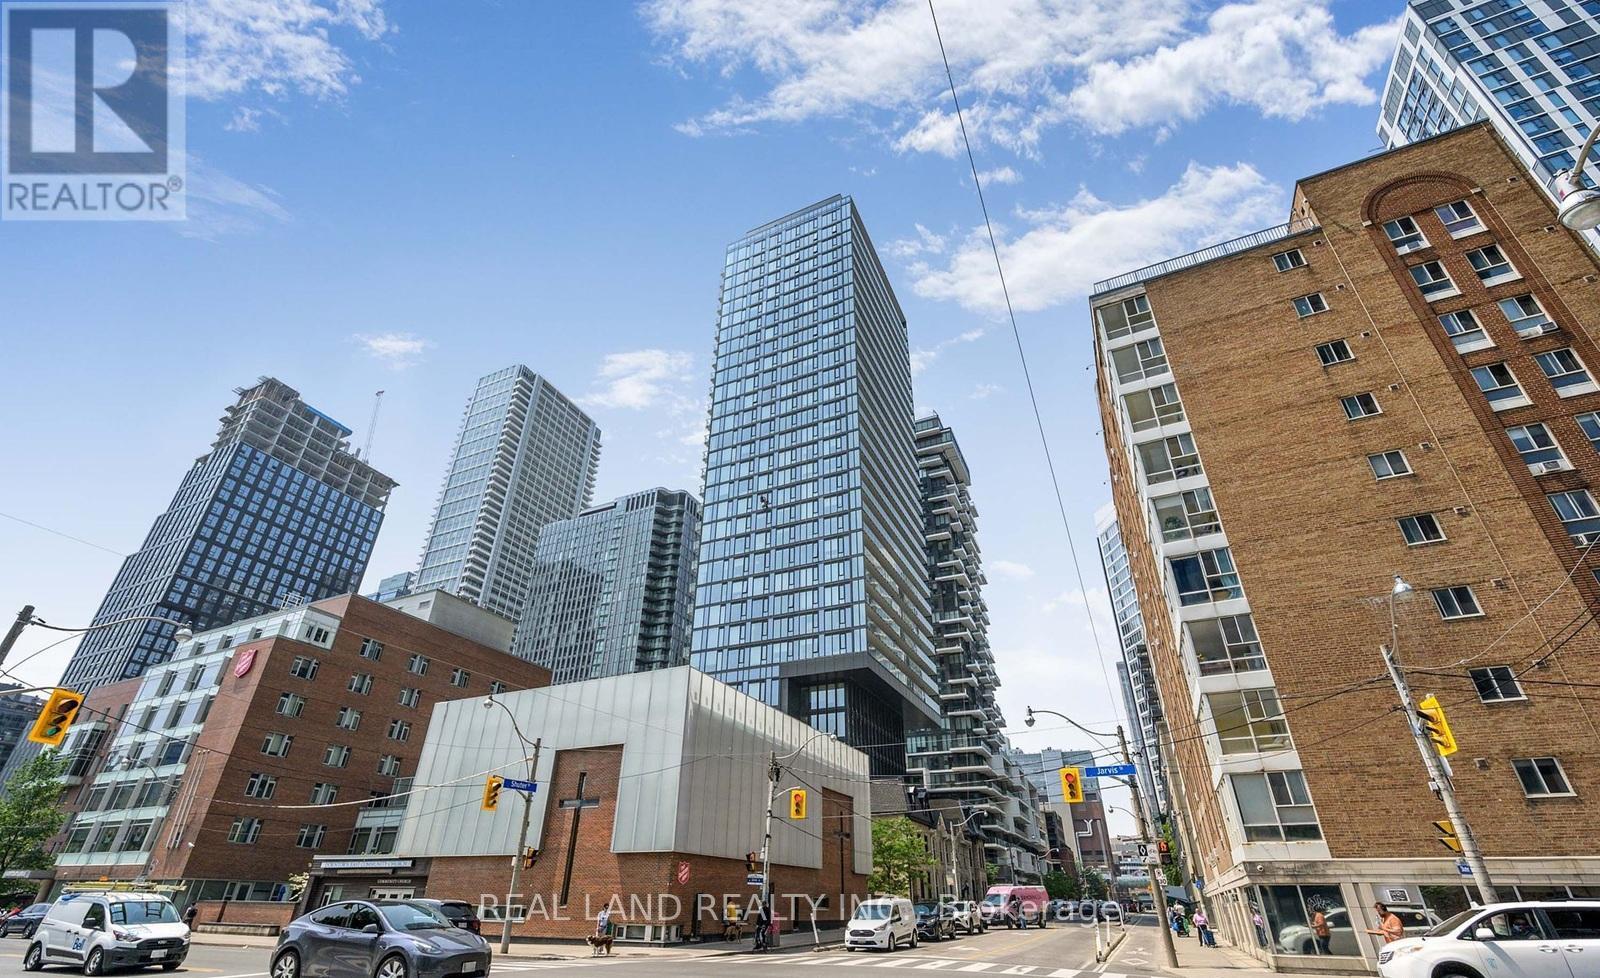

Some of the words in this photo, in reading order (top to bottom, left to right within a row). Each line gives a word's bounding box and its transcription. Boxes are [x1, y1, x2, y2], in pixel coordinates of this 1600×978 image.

[1096, 766, 1118, 775] Jarvis
[511, 780, 527, 790] Shuter
[72, 937, 86, 950] Bell
